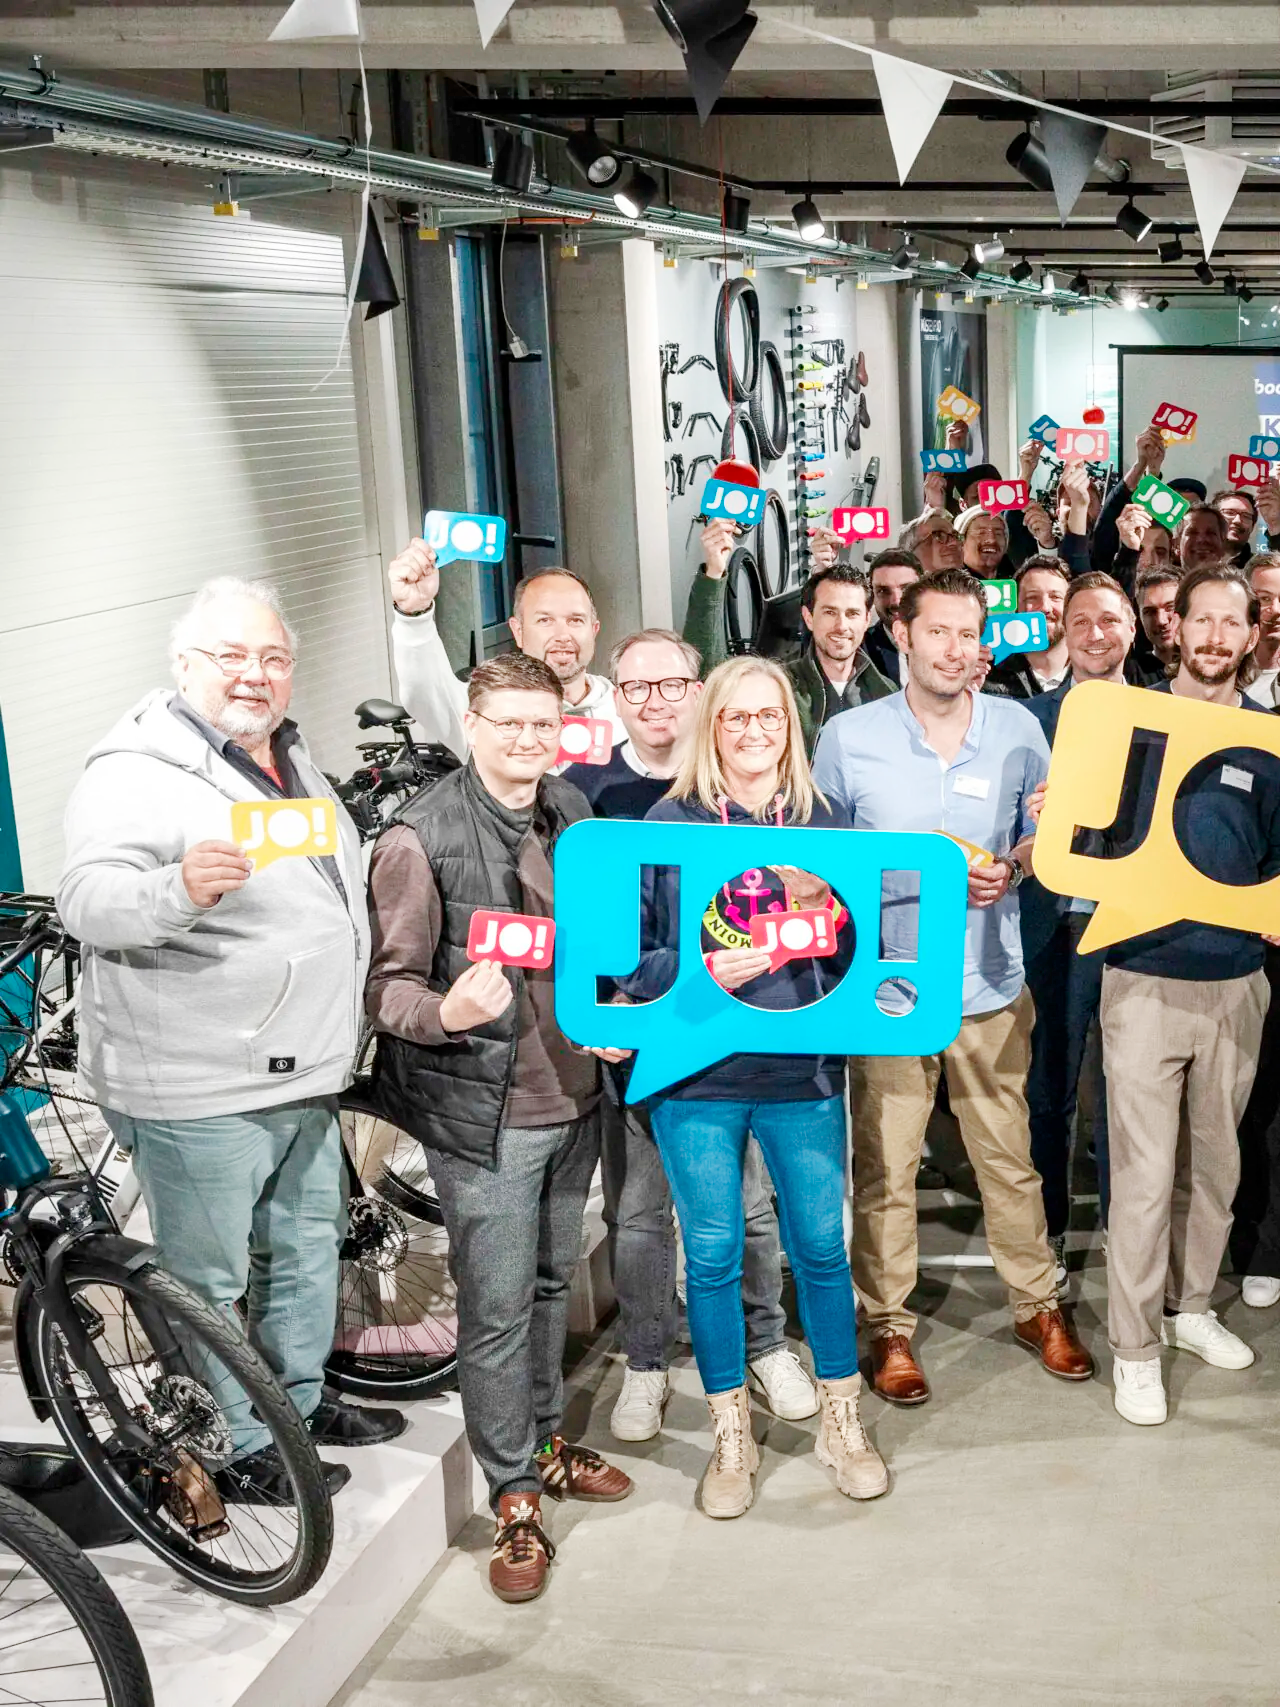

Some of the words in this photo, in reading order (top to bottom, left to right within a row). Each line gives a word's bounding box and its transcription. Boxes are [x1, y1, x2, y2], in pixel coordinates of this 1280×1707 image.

[941, 392, 976, 421] JO!
[1155, 407, 1194, 431] JO!
[1033, 420, 1056, 448] JO
[1060, 433, 1104, 456] JO!
[928, 452, 962, 469] JO!
[1231, 459, 1266, 483] JO!
[706, 486, 760, 519] JO!
[984, 484, 1024, 506] JO!
[1136, 483, 1184, 523] JO!
[429, 520, 496, 555] JO!
[837, 511, 885, 535] JO!
[984, 584, 1011, 608] O!
[986, 617, 1041, 648] JO!
[559, 723, 605, 757] O!
[242, 807, 329, 848] JO!
[475, 919, 547, 960] JO!
[595, 863, 922, 1018] JO!
[708, 919, 752, 949] MOIN
[759, 915, 828, 954] JO!
